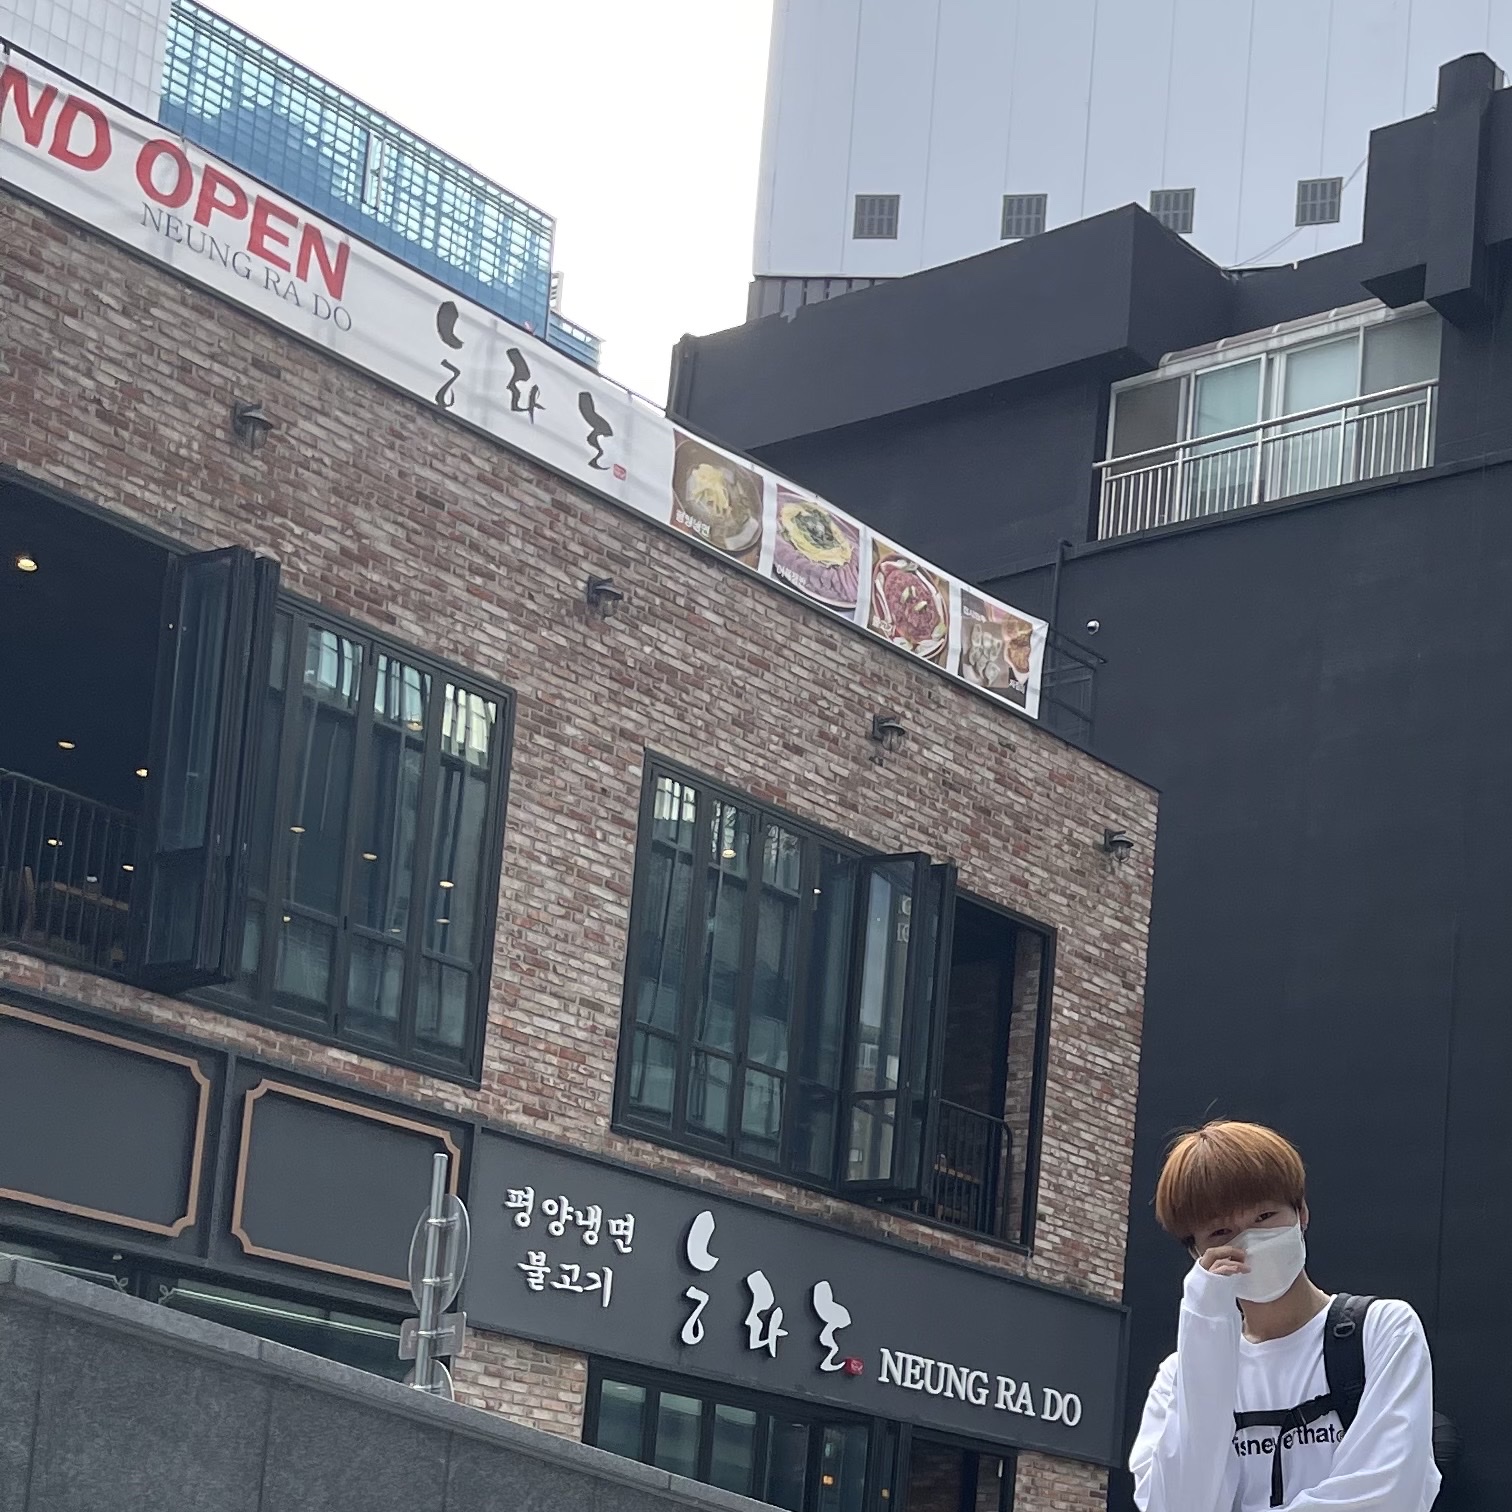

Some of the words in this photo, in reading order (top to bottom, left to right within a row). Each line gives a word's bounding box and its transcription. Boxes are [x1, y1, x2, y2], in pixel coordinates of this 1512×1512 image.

[136, 139, 351, 302] OPEN
[141, 202, 253, 281] NEUNG
[264, 266, 304, 309] RA
[313, 294, 352, 332] DO
[504, 1186, 635, 1254] 평양냉면
[518, 1250, 613, 1308] 불고기
[877, 1348, 990, 1406] NEUNG
[994, 1375, 1036, 1417] RA
[1040, 1387, 1083, 1427] DO
